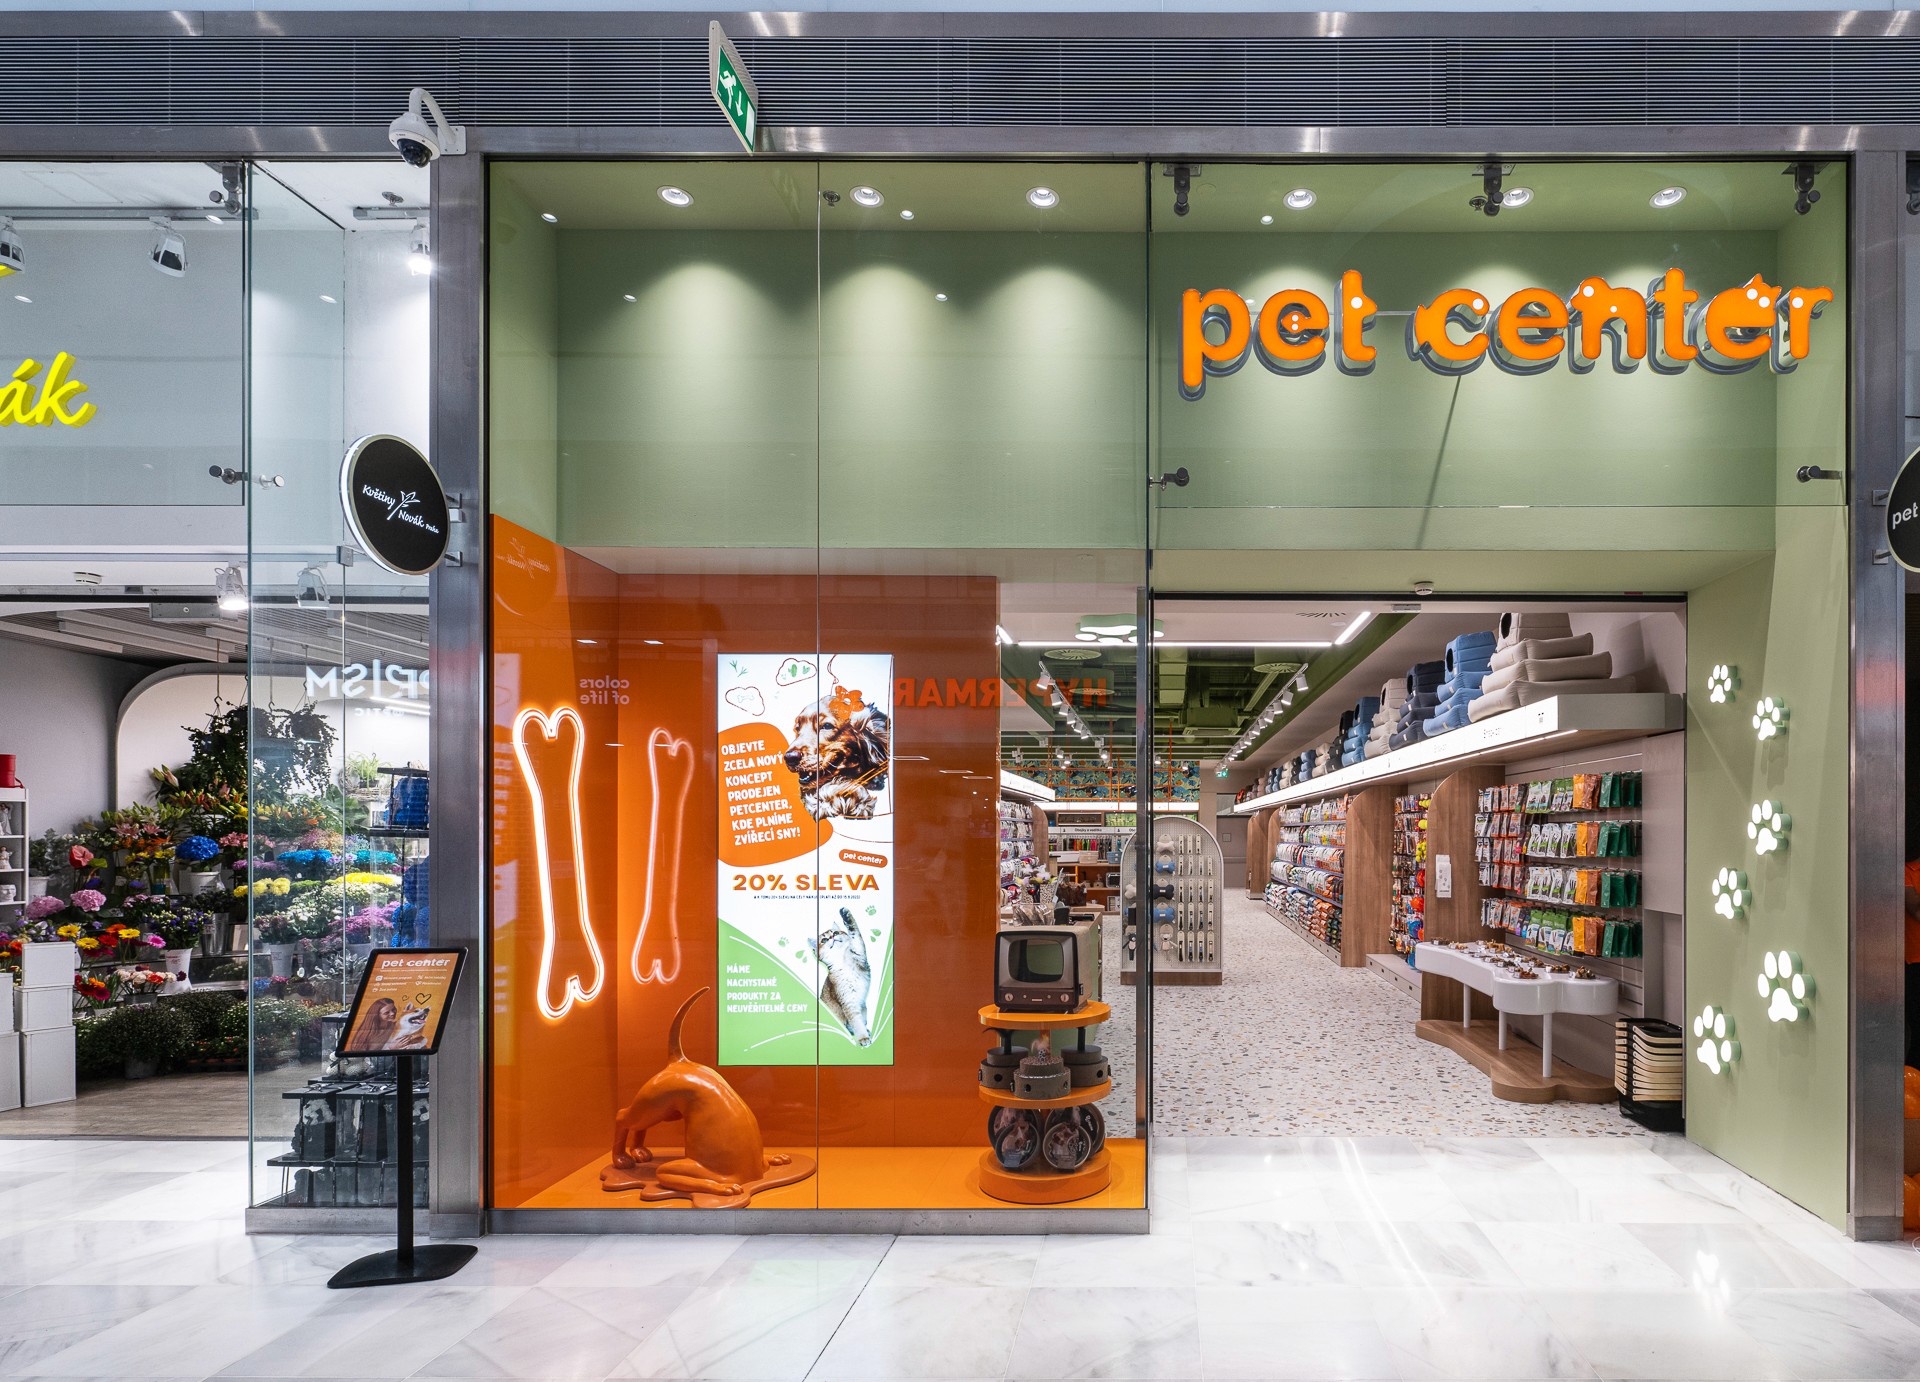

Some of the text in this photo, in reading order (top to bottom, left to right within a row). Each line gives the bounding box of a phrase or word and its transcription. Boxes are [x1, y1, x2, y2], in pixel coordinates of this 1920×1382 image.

[1178, 266, 1834, 401] pet center
[362, 484, 396, 510] Květiny
[398, 509, 425, 528] Novák
[1892, 502, 1919, 530] pet
[721, 740, 765, 756] OBJEVTE
[723, 751, 784, 772] ZCELA NOVÝ
[725, 771, 773, 787] KONCEPT
[727, 785, 781, 802] PRODEJEN
[729, 799, 793, 816] PETCENTER,
[731, 811, 794, 831] KDE PLNÍME
[734, 827, 801, 846] ZVÍŘECÍ SNY!
[842, 851, 884, 865] pet center
[732, 874, 880, 891] 20% SLEVA
[381, 957, 451, 969] pet center
[726, 963, 751, 974] MÁME
[726, 976, 777, 987] NACHYSTANÉ
[726, 992, 781, 1001] PRODUKTY ZA
[726, 1002, 808, 1013] NEUVĚŘITELNÉ CENY
